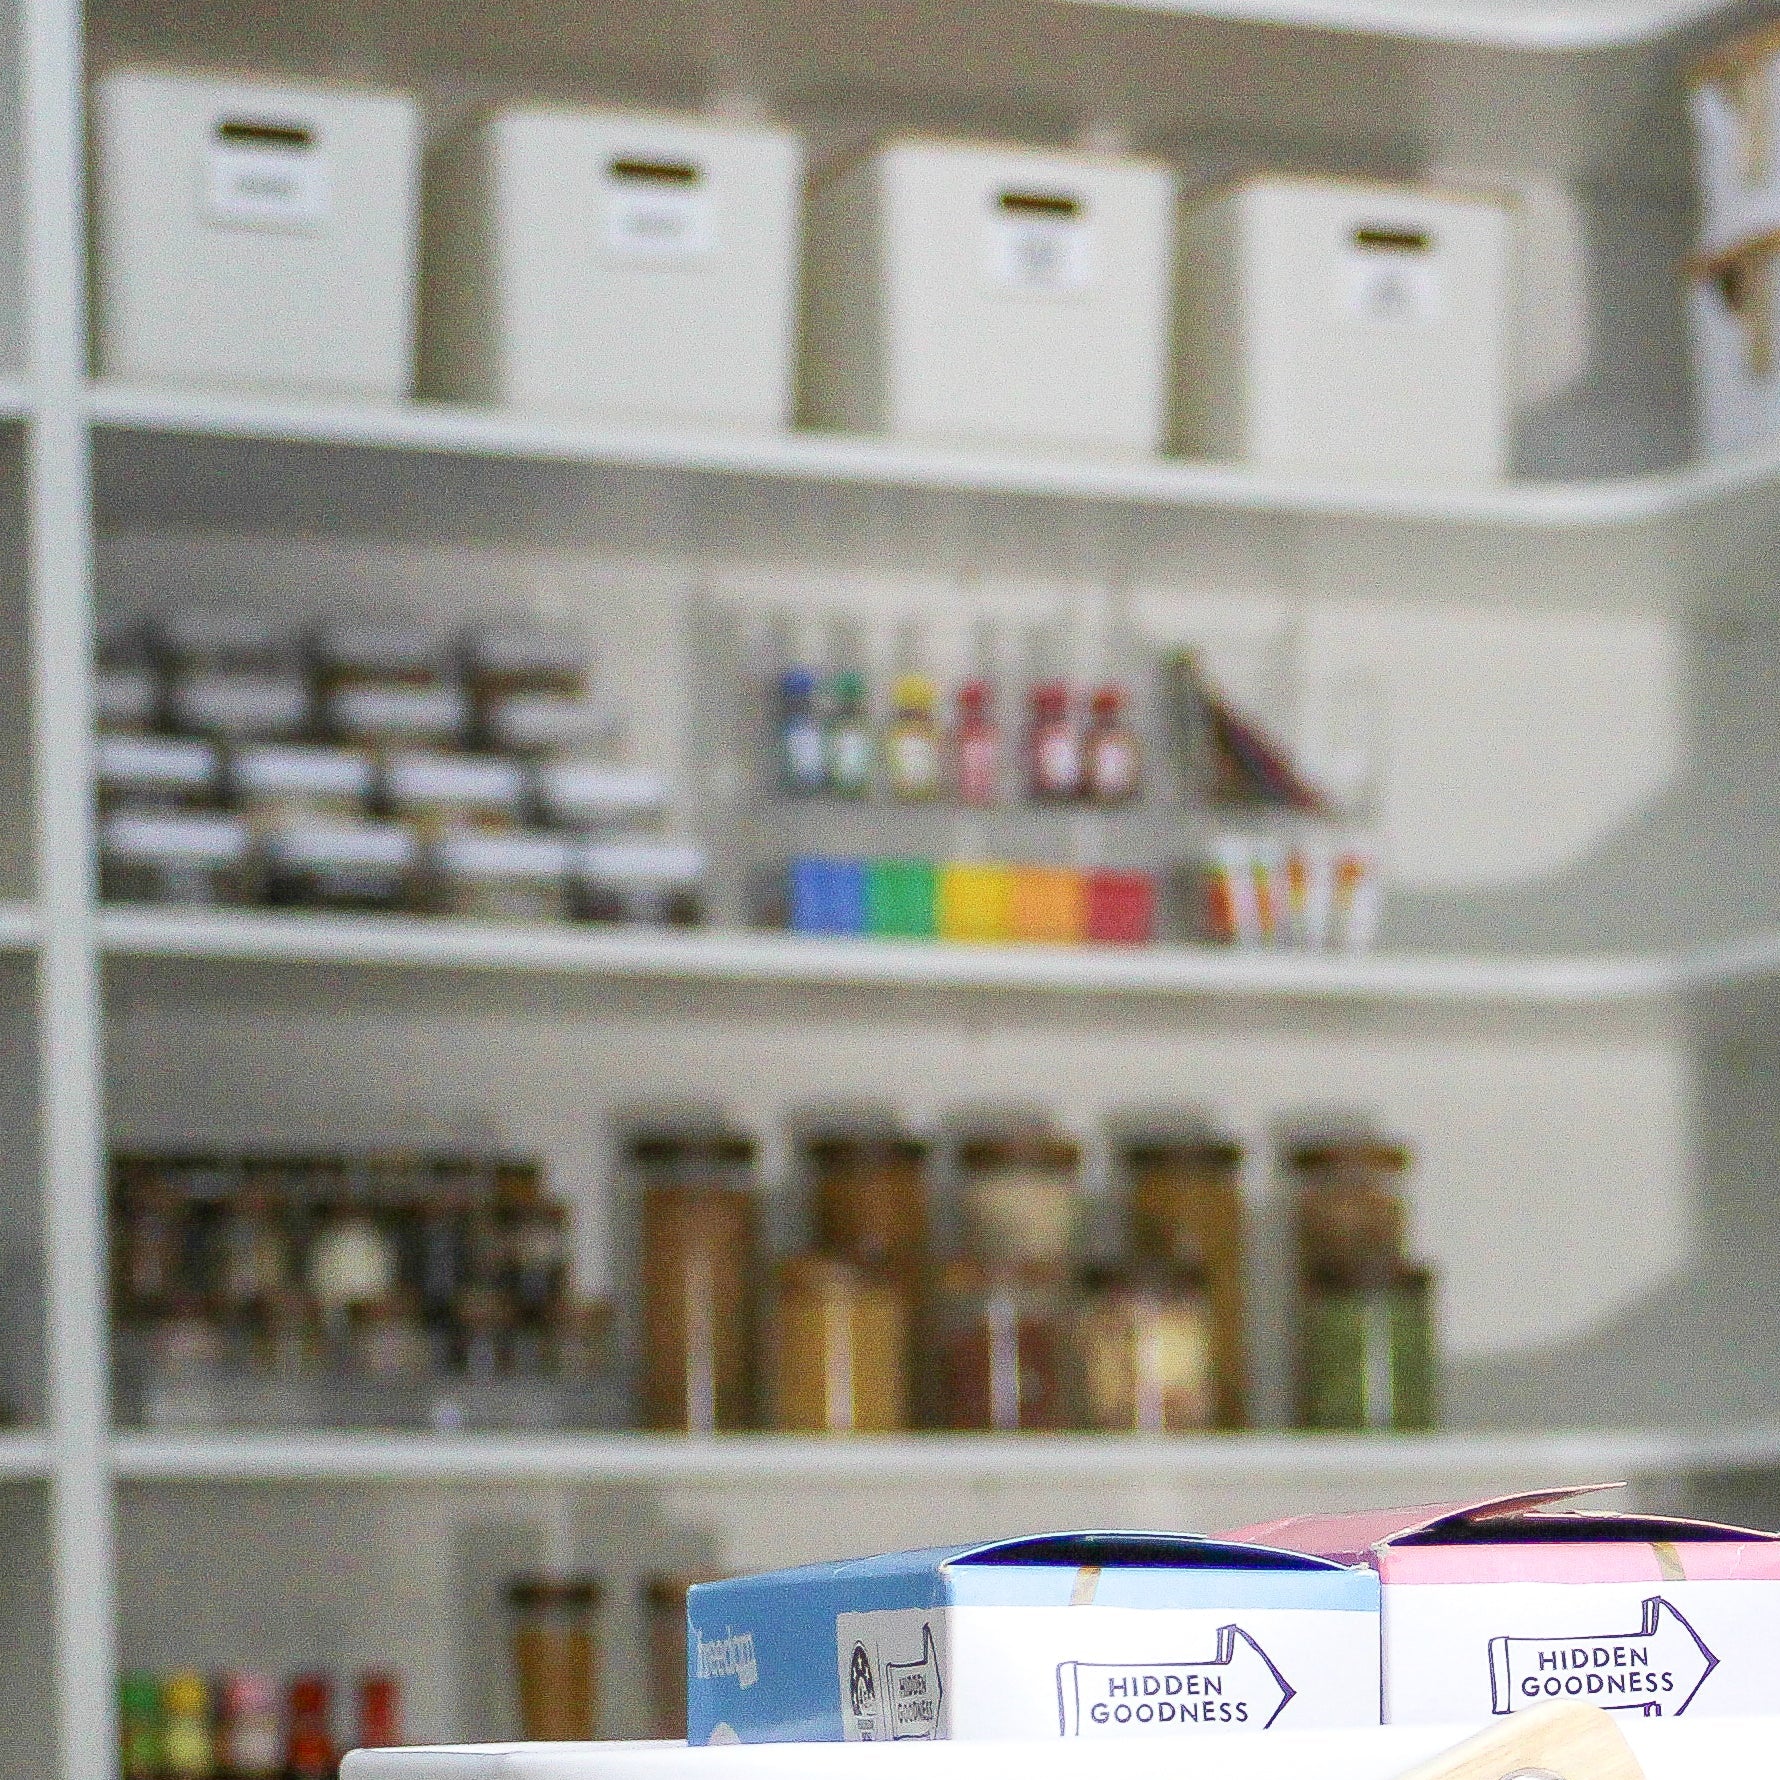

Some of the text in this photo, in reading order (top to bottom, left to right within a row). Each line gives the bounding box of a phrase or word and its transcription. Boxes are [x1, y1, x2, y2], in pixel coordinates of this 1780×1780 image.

[1538, 1647, 1648, 1671] HIDDEN
[1108, 1675, 1222, 1697] HIDDEN
[1521, 1672, 1674, 1697] GOODNESS
[1091, 1701, 1249, 1723] GOODNESS
